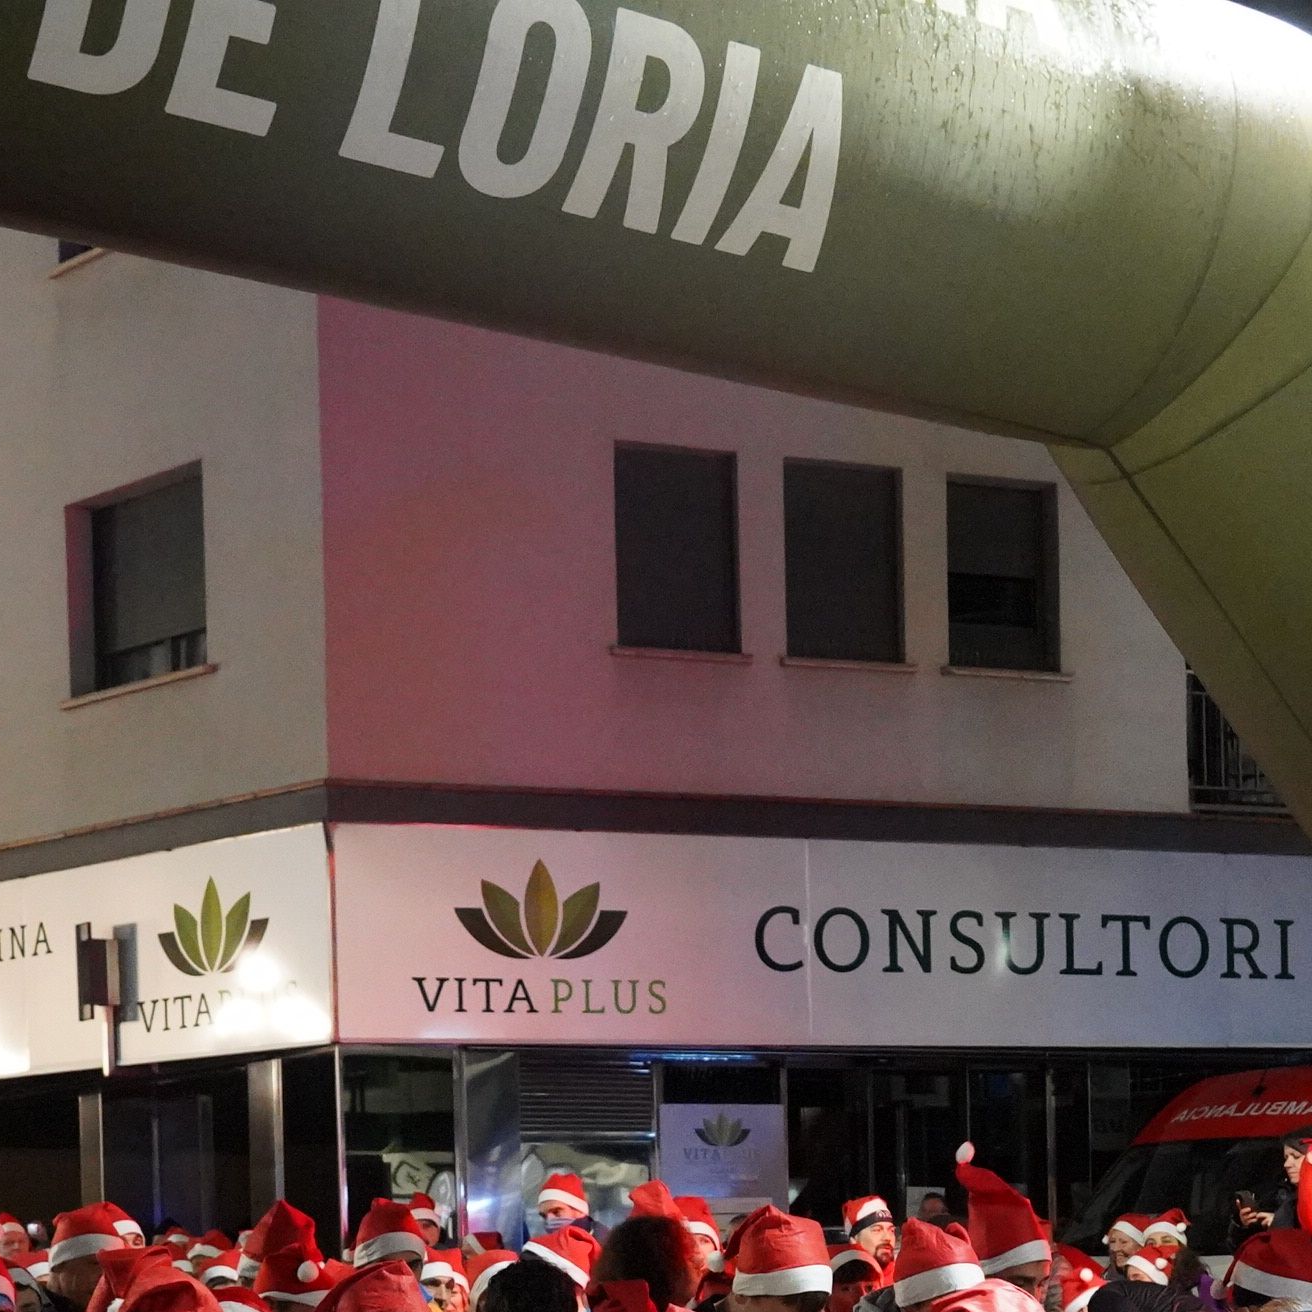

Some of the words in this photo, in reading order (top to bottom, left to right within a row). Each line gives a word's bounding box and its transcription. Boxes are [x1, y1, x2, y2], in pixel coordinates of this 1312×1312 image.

[26, 0, 277, 136] DE
[755, 905, 1296, 980] CONSULTORI
[413, 976, 537, 1013] VITA
[551, 978, 667, 1015] PLUS
